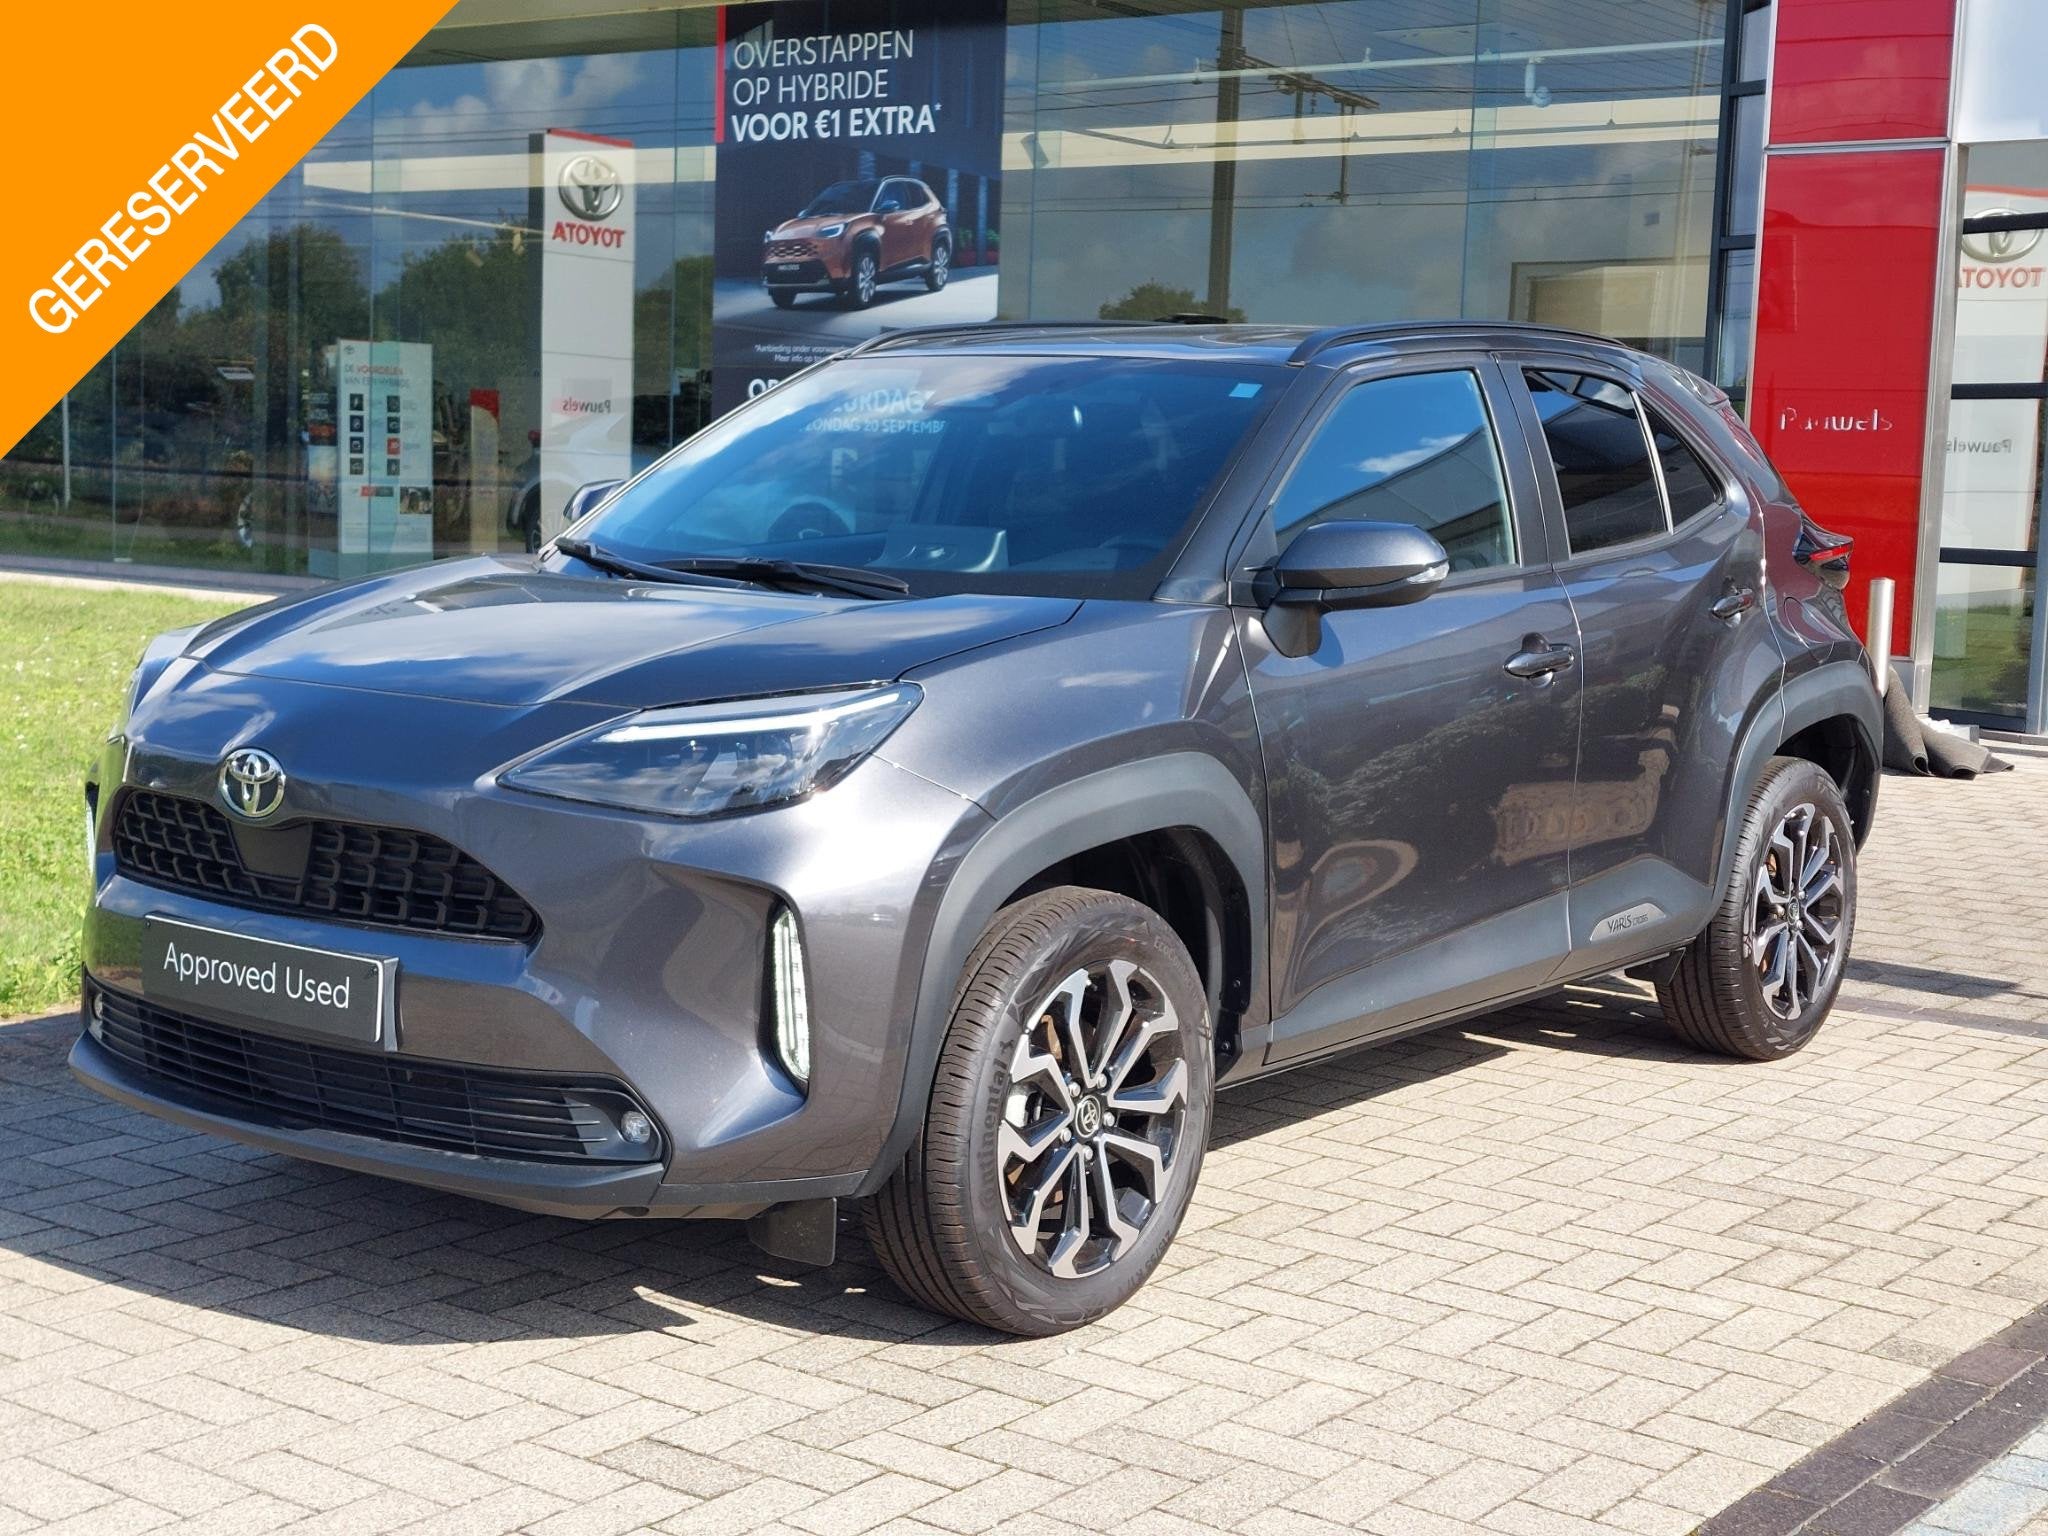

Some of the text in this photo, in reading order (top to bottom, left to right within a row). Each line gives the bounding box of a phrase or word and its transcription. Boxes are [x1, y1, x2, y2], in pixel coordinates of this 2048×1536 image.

[733, 29, 914, 69] OVERSTAPPEN
[733, 69, 888, 106] OP HYBRIDE
[731, 112, 808, 142] VOOR
[815, 109, 841, 138] €1
[163, 942, 350, 1009] Approved Used
